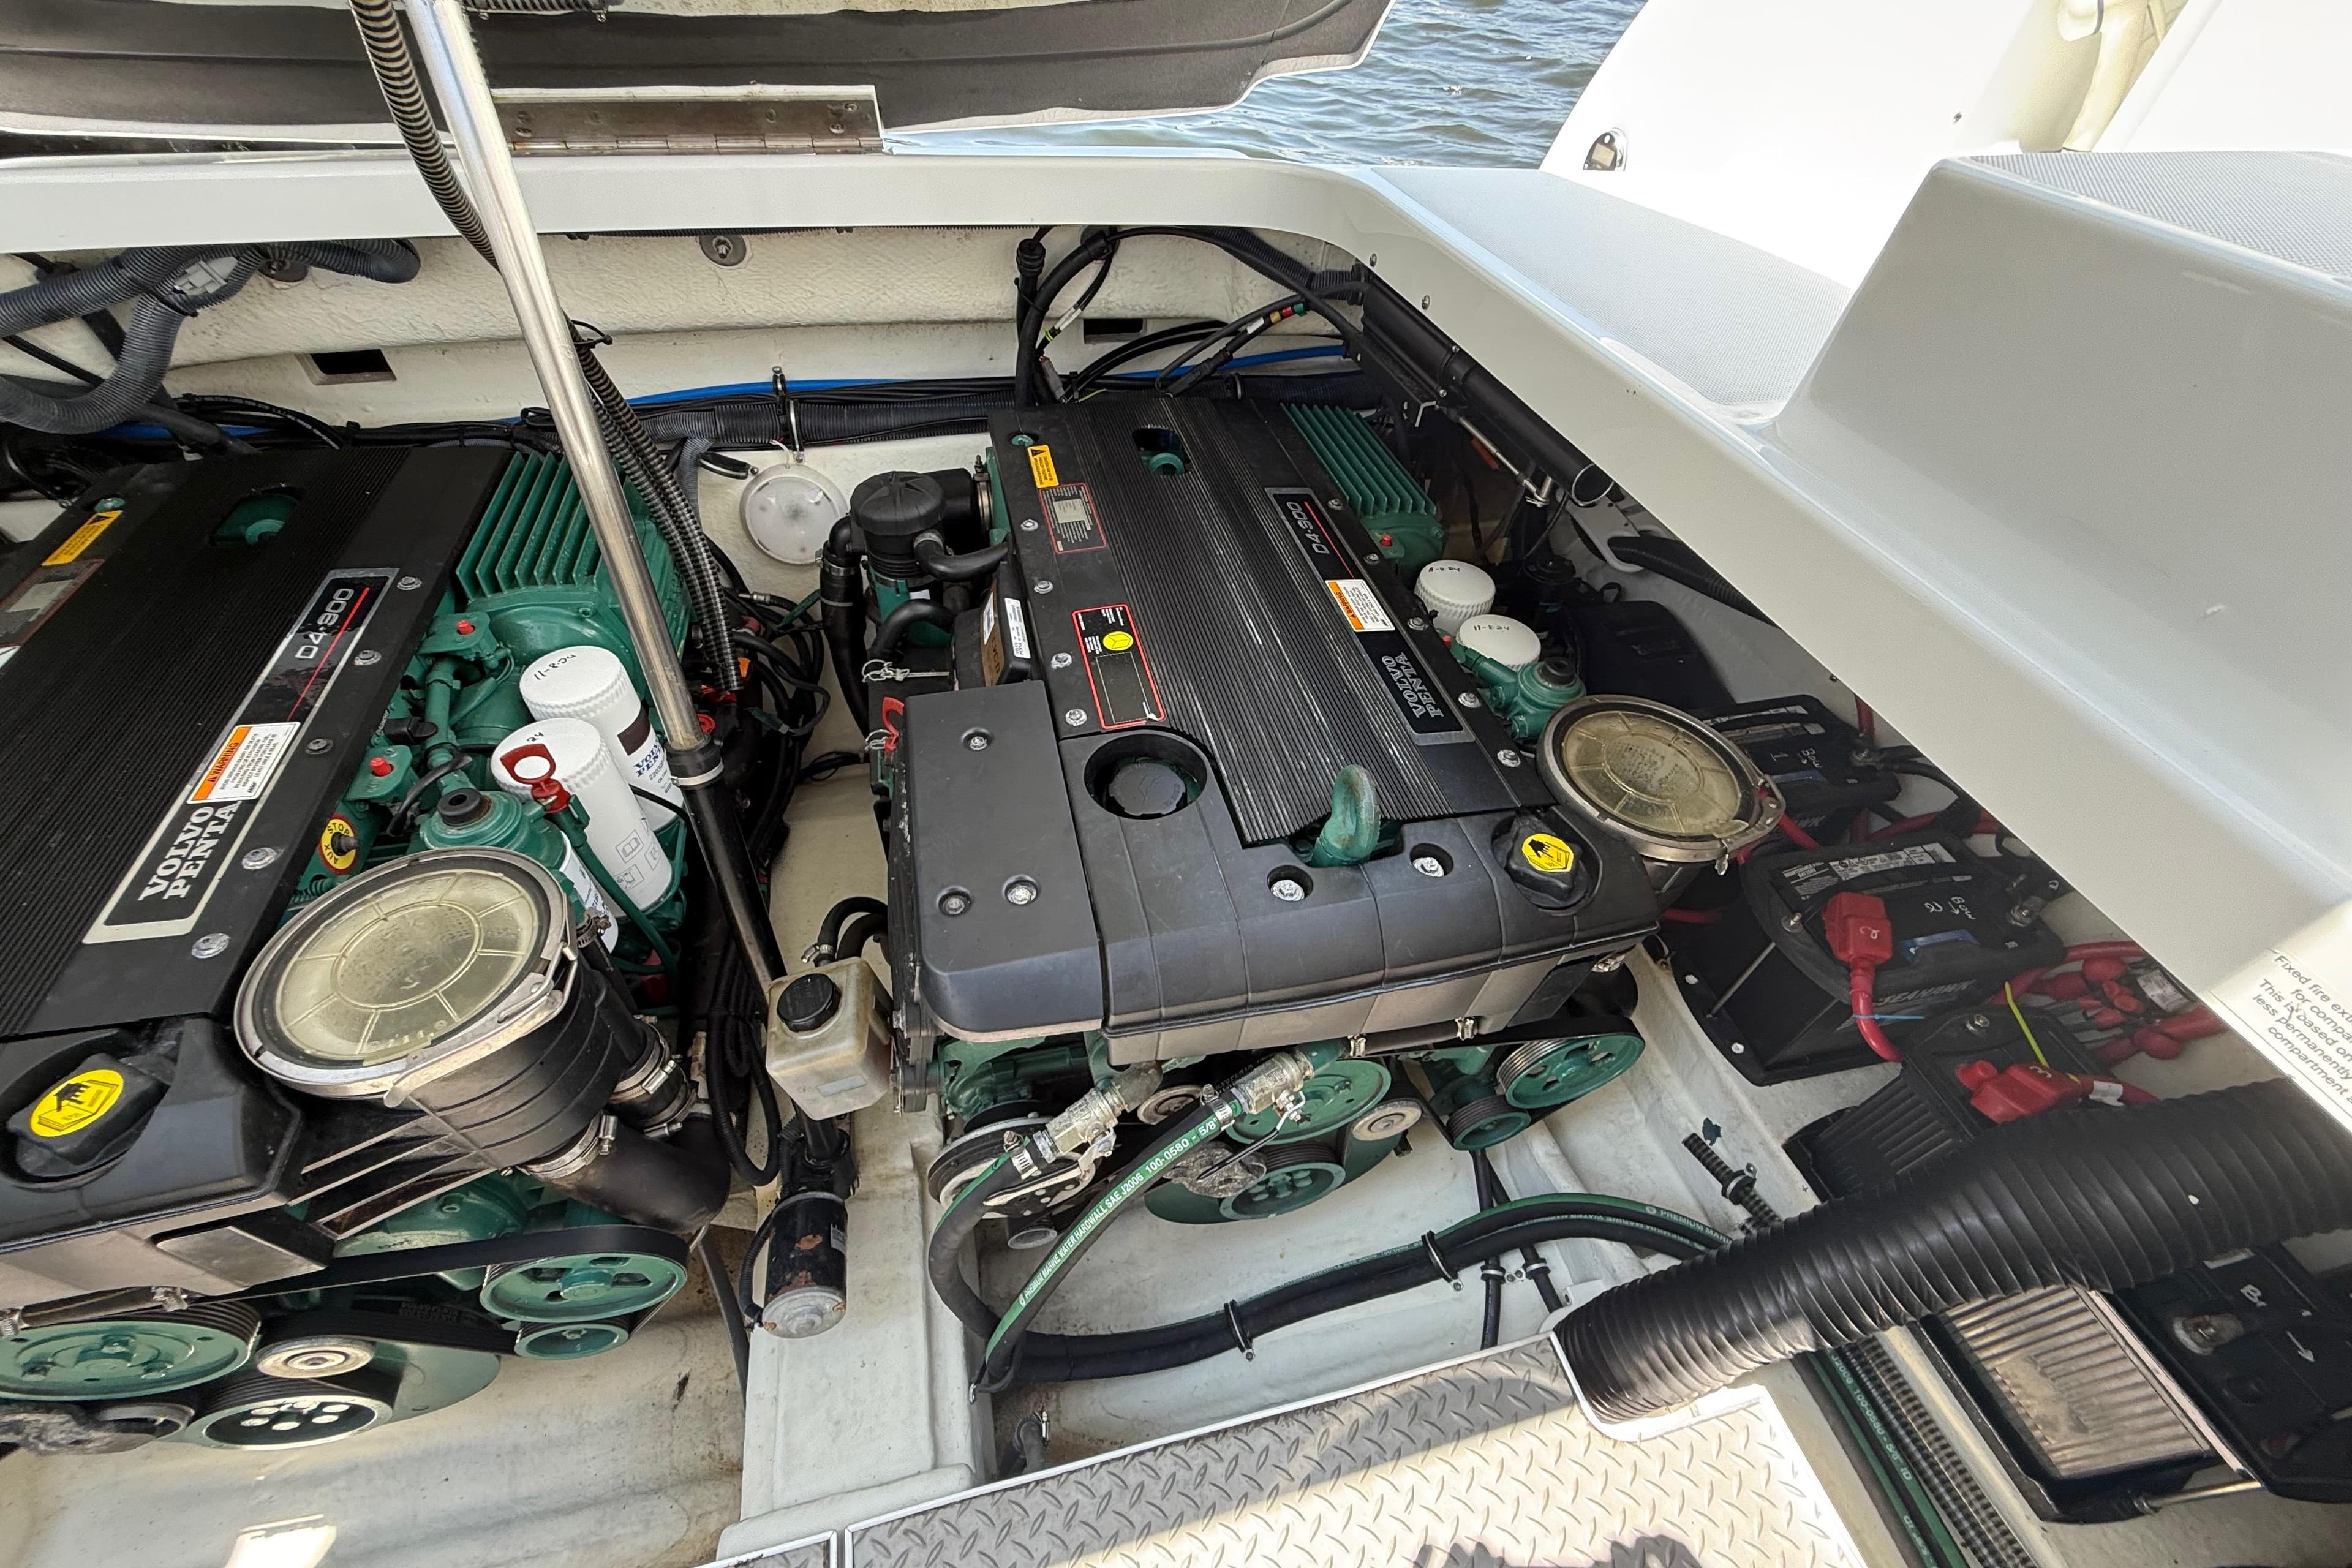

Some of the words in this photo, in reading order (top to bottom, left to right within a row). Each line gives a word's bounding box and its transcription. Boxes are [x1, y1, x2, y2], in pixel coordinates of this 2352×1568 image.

[1335, 592, 1352, 613] WARNING
[1382, 655, 1426, 718] VOLVO
[1395, 652, 1445, 718] PENTA
[212, 742, 239, 775] WARNING
[138, 807, 214, 901] VOLVO
[163, 800, 243, 899] PENTA
[325, 844, 339, 864] AUX
[328, 822, 350, 834] STOP
[2274, 956, 2312, 984] Fixed
[2308, 984, 2331, 1002] fire
[2291, 989, 2312, 1004] for
[2252, 994, 2278, 1016] less
[2275, 1016, 2352, 1080] permanently
[2259, 978, 2285, 1002] This
[2283, 1001, 2296, 1013] is
[2296, 1011, 2339, 1046] based
[2267, 1026, 2349, 1095] compartment
[1024, 1274, 1042, 1300] PREMIUM
[1041, 1254, 1059, 1283] MARINE
[1058, 1235, 1077, 1262] WATER
[1074, 1206, 1109, 1243] HARDWALL
[1105, 1191, 1123, 1209] SAE
[1121, 1172, 1144, 1195] J2006
[1145, 1138, 1190, 1174] 100-0580
[1198, 1117, 1218, 1136] 5/8"
[1660, 1210, 1703, 1231] PREMIUM
[1853, 1389, 1885, 1436] 100-0580
[1900, 1467, 1912, 1481] ID
